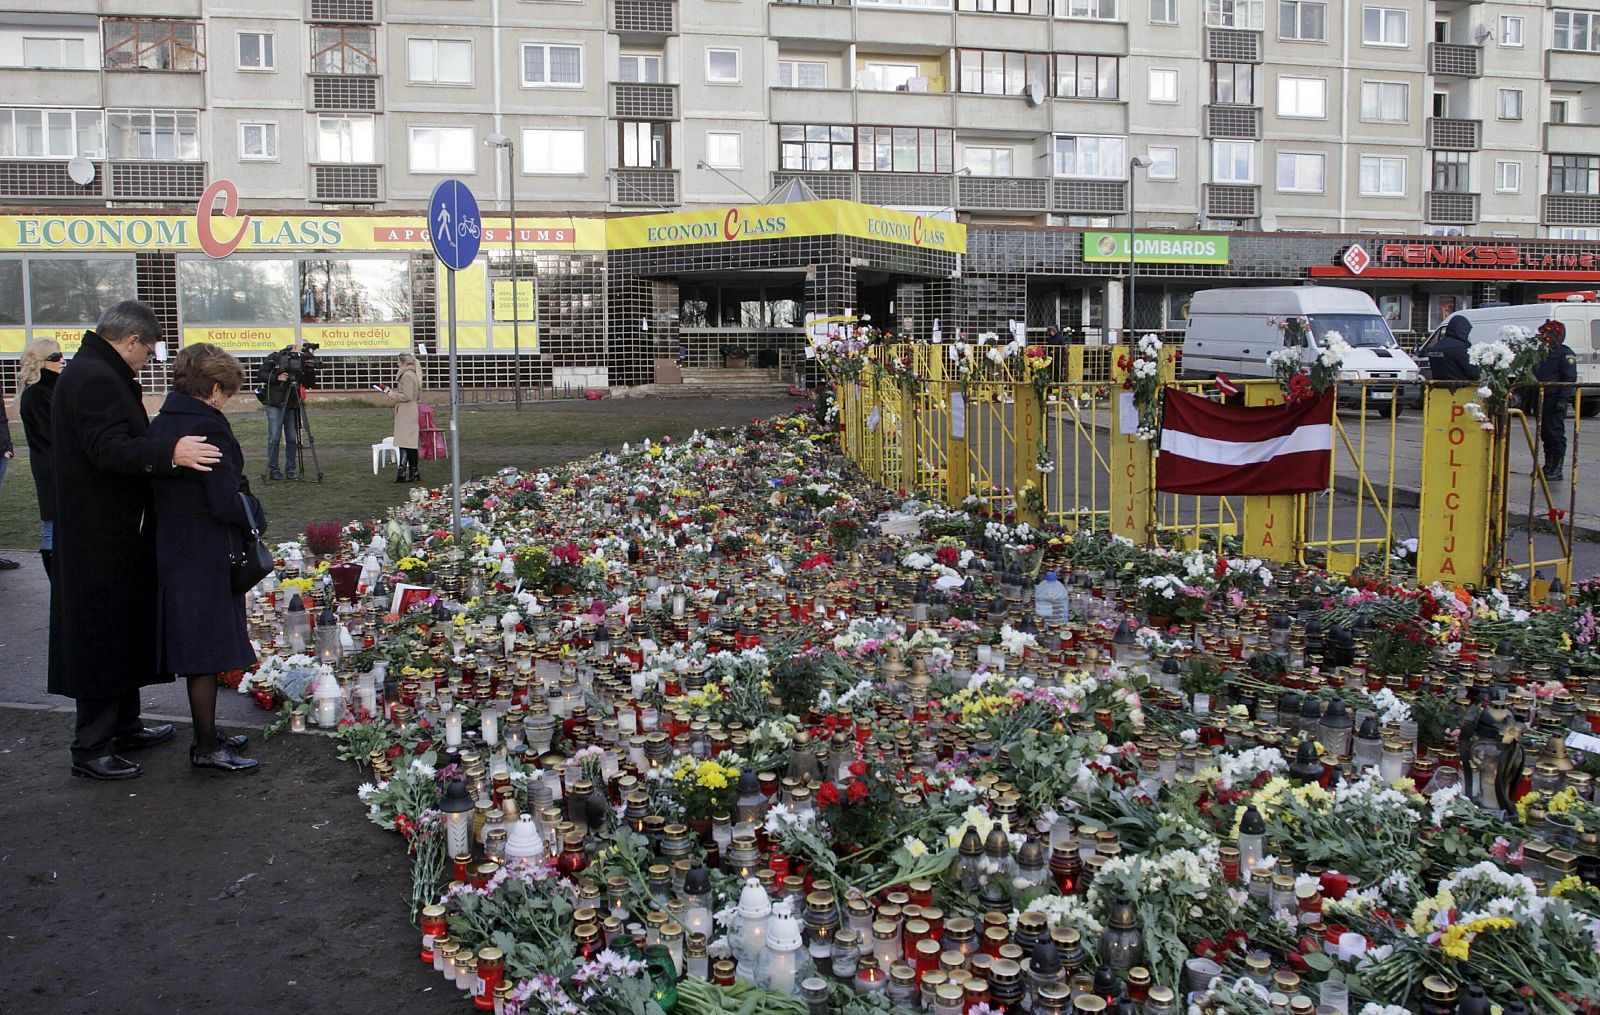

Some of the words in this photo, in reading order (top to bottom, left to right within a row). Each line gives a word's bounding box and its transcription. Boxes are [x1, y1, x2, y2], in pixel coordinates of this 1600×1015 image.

[16, 219, 189, 246] ECONOM
[197, 179, 343, 258] CLASS
[647, 222, 719, 241] ECONOM
[724, 208, 787, 240] CLASS
[868, 218, 912, 240] ECONOM
[913, 215, 945, 246] CLASS
[506, 230, 565, 241] JUMS
[1123, 239, 1216, 256] LOMBARDS
[1381, 243, 1520, 265] FENIKSS
[208, 330, 236, 340] Katru
[240, 330, 272, 340] dienu
[321, 329, 350, 338] Katru
[353, 329, 391, 340] nedēļu
[1125, 434, 1136, 530] LICIJA
[1439, 405, 1465, 575] POLICIJA
